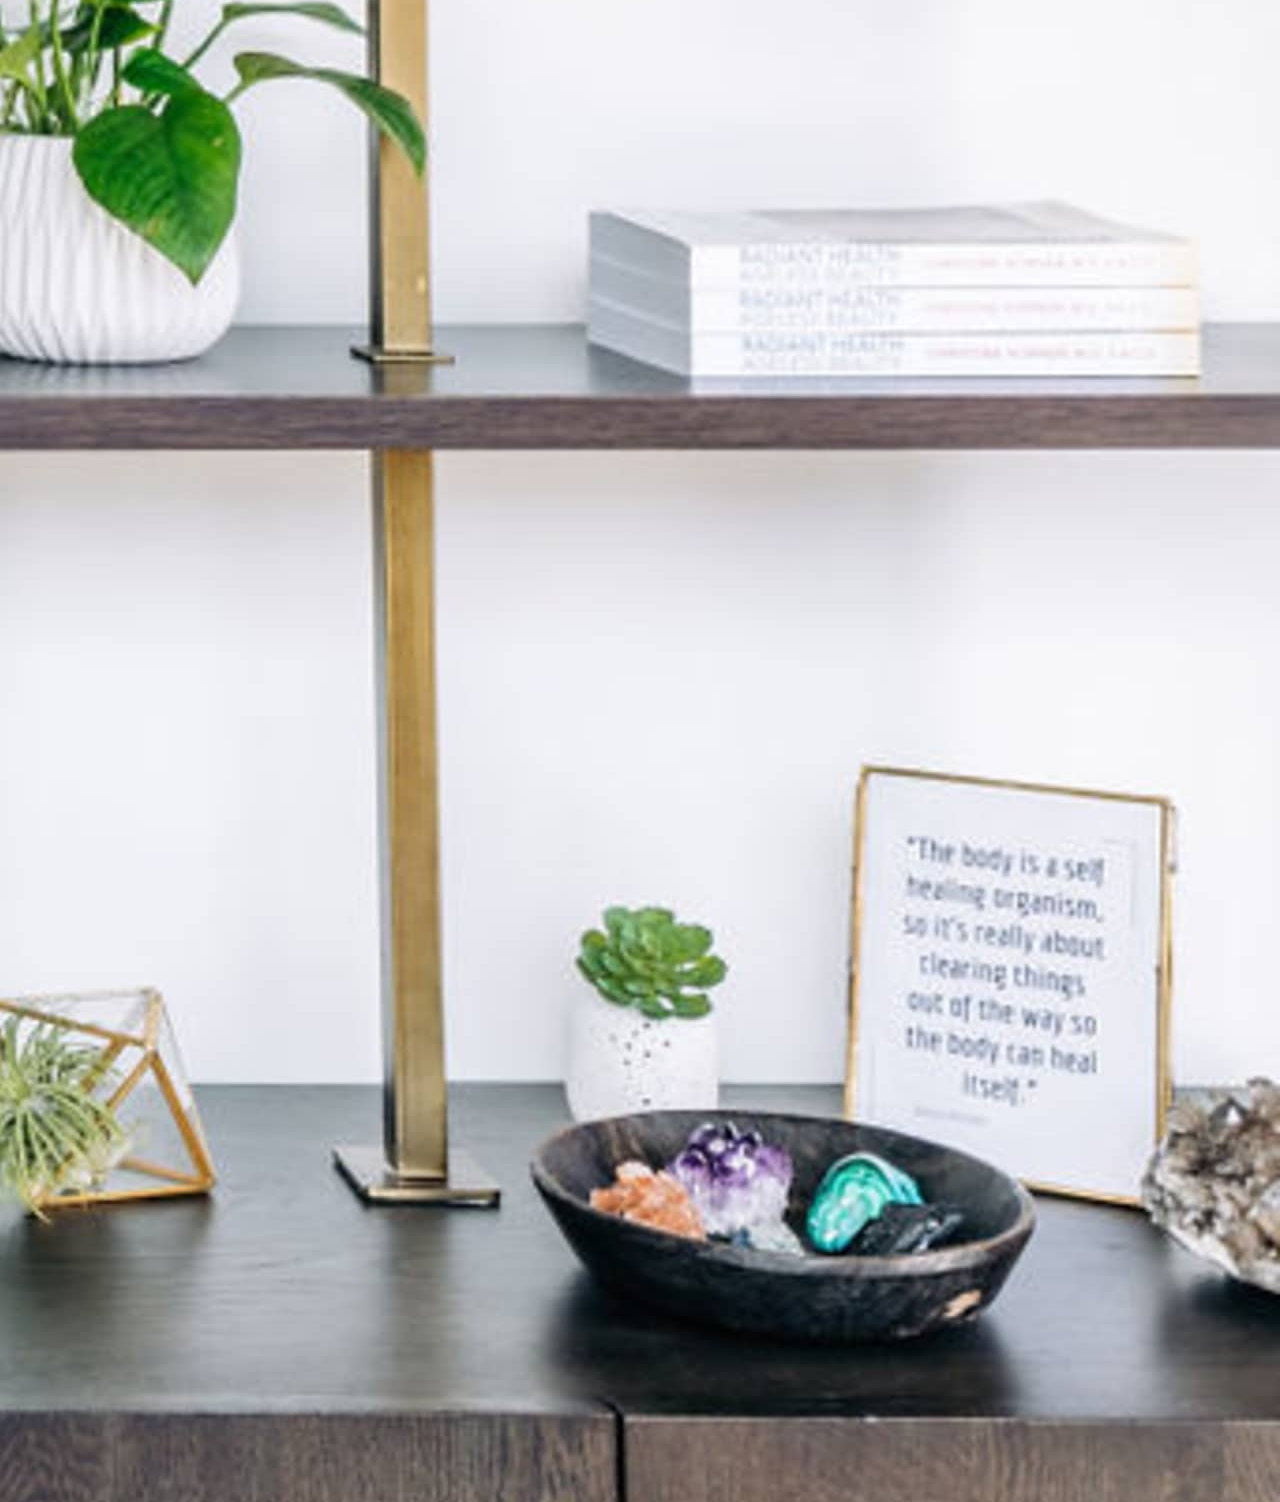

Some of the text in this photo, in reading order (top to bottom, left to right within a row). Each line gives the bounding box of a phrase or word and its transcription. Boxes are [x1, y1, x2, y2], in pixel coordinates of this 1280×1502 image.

[960, 842, 1013, 876] body
[1020, 850, 1039, 876] is
[1045, 856, 1058, 878] a
[1063, 856, 1105, 887] self
[906, 874, 1104, 924] healing organism,
[902, 913, 1106, 960] so it's really about
[919, 952, 1087, 1000] clearing things
[906, 991, 1098, 1037] out of the way so
[905, 1025, 1098, 1074] the body can heal
